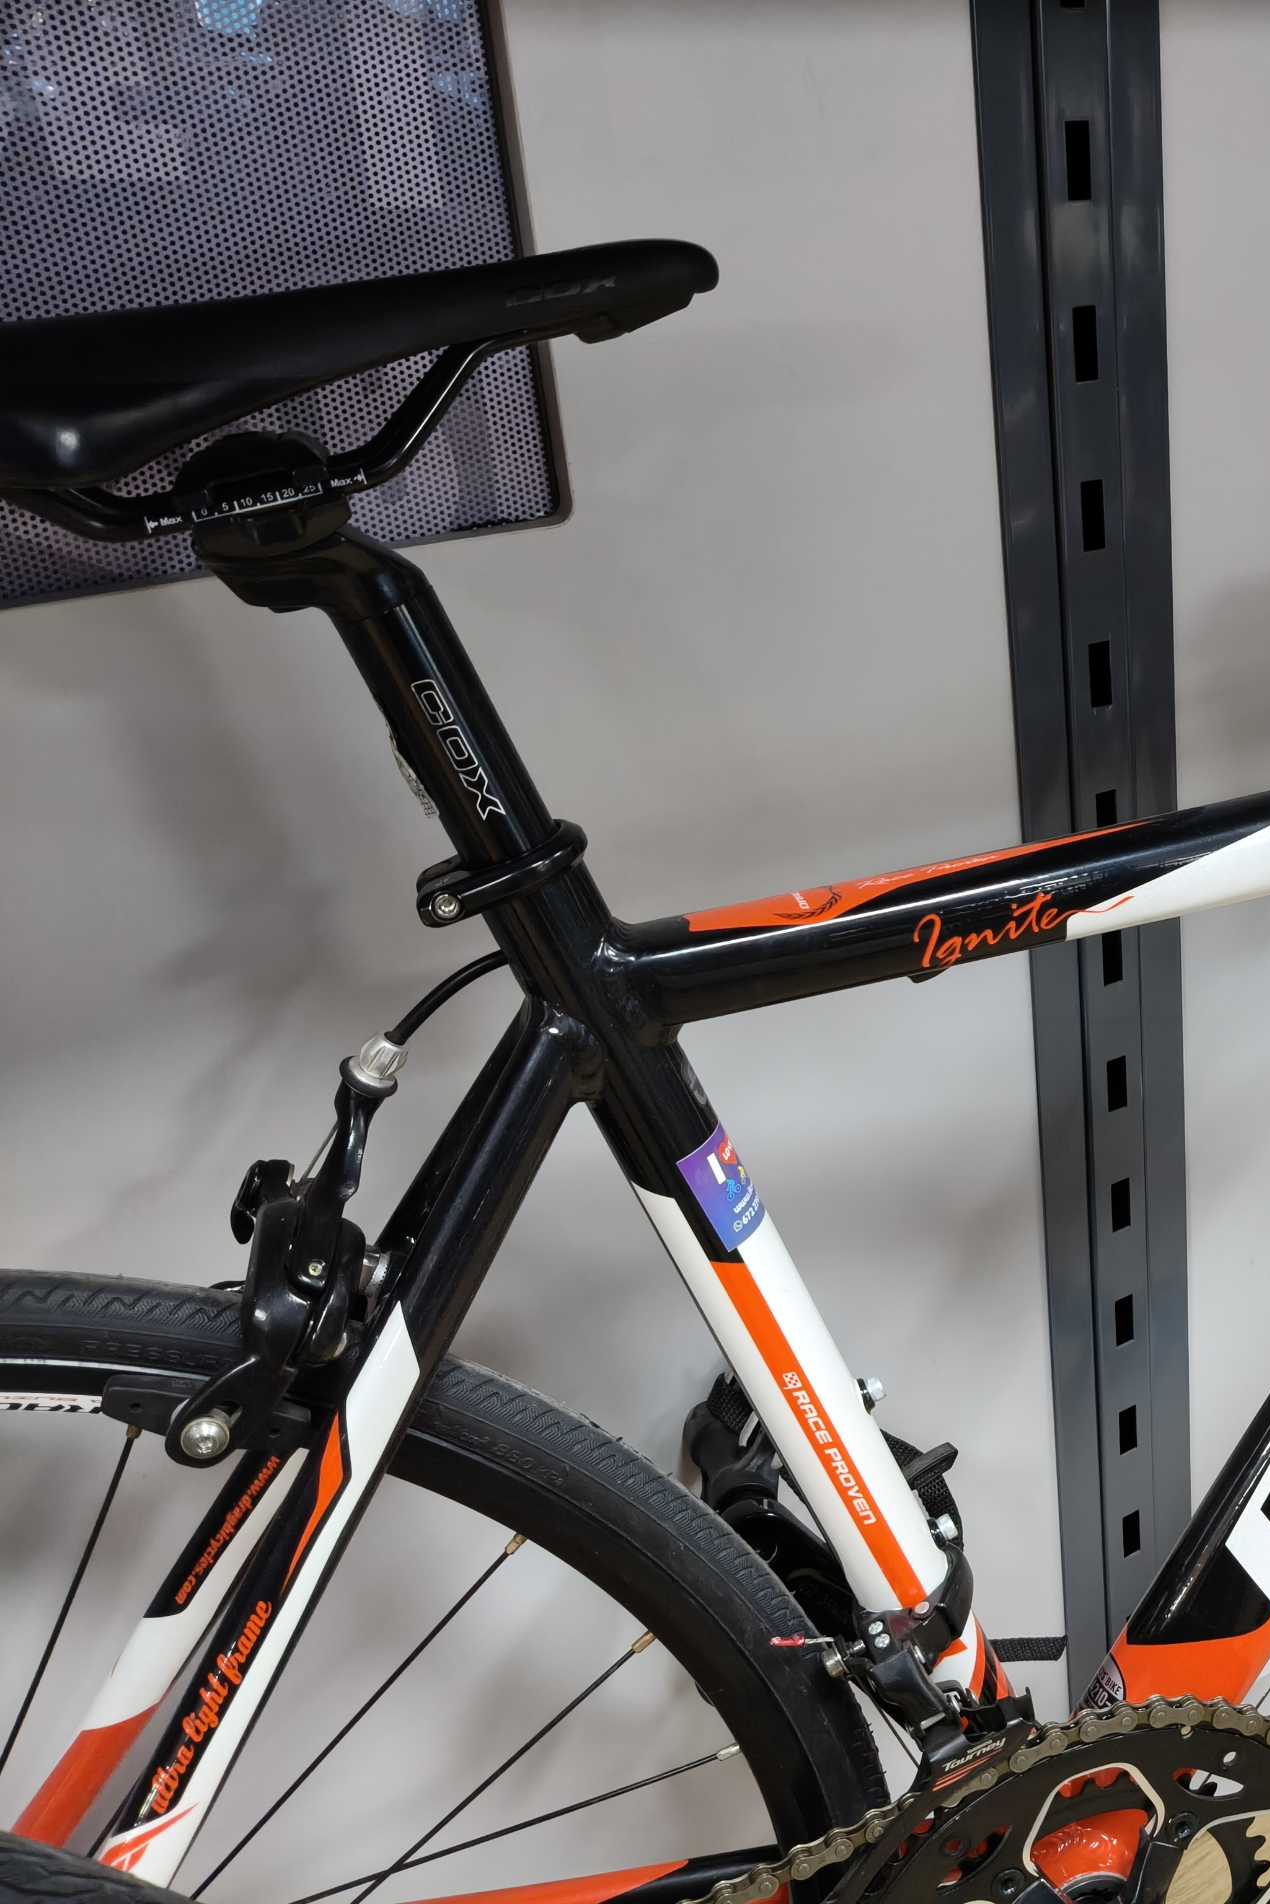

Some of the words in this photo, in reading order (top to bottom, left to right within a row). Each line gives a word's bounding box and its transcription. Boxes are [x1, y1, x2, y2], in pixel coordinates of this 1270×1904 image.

[241, 495, 253, 507] 10
[261, 491, 274, 503] 15
[282, 487, 295, 499] 20
[330, 476, 353, 488] Max
[411, 679, 506, 821] COX
[913, 891, 1095, 968] Ignite
[793, 1391, 832, 1445] RACE
[824, 1447, 877, 1525] PROVEN
[151, 1744, 195, 1815] ultra
[182, 1671, 229, 1743] light
[216, 1600, 272, 1686] frame
[941, 1737, 1006, 1772] Tourney
